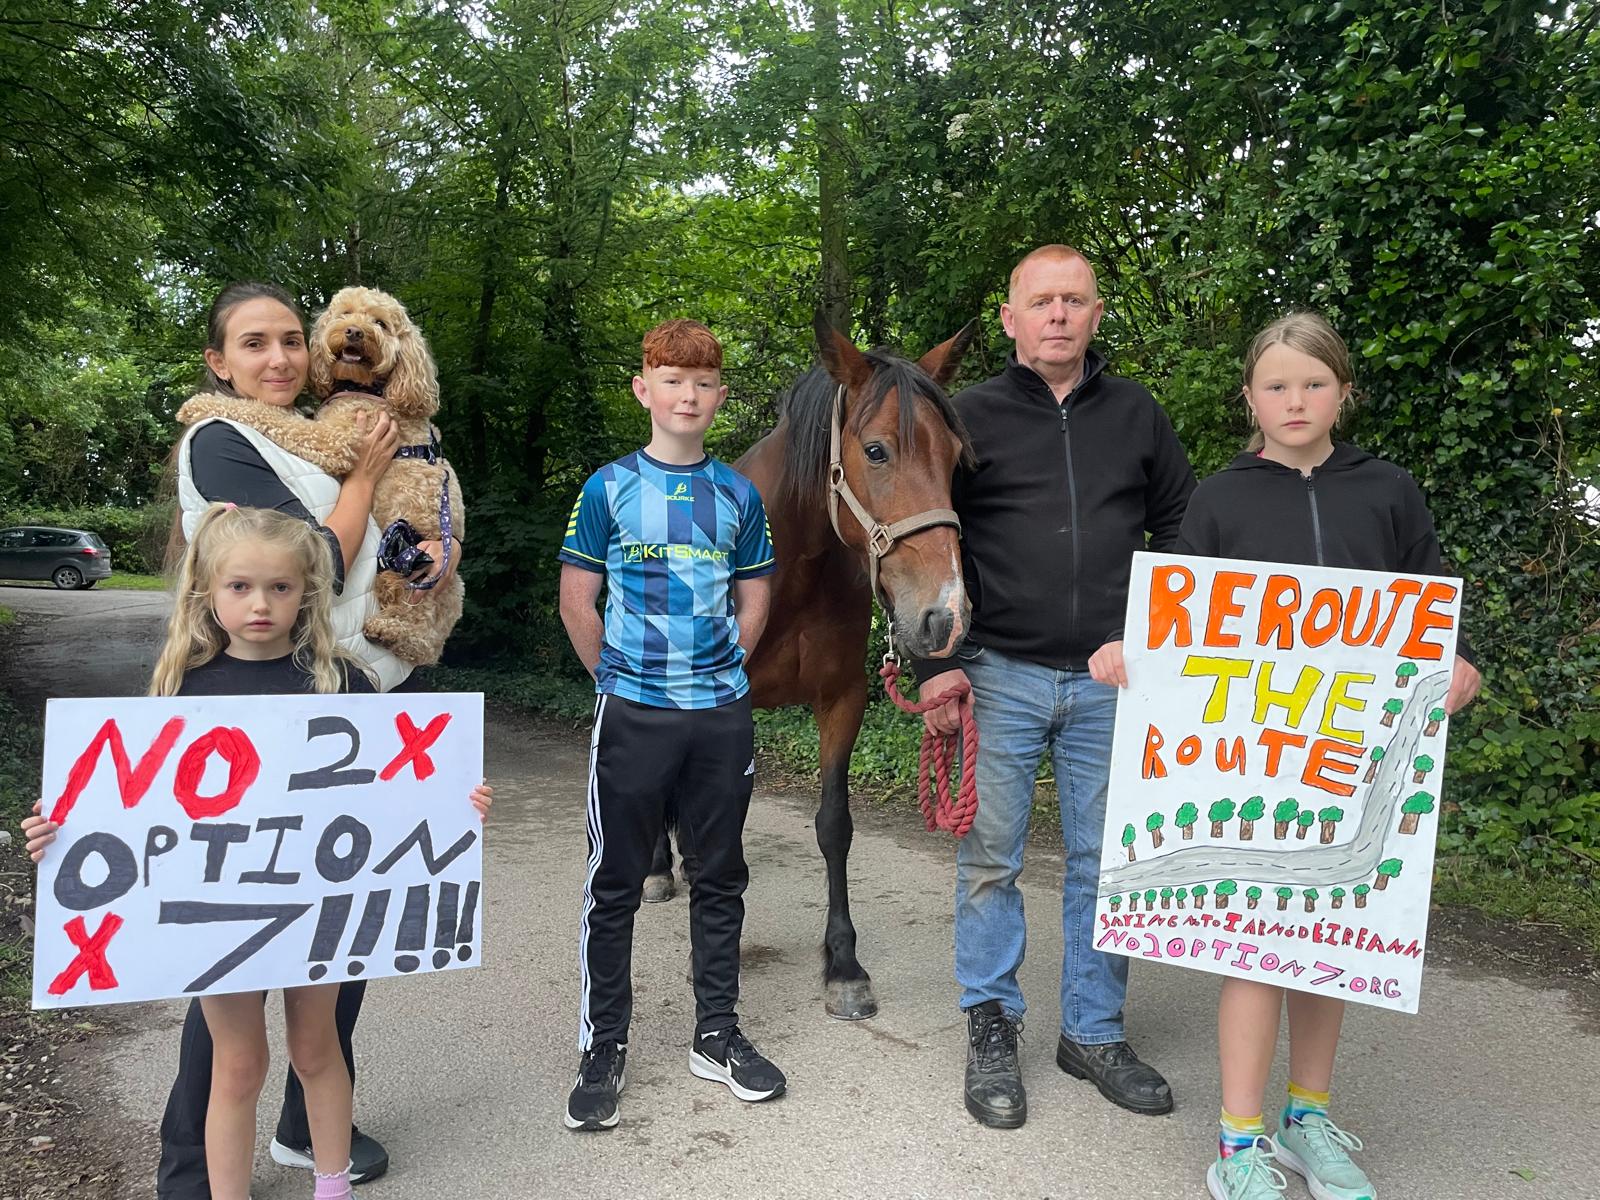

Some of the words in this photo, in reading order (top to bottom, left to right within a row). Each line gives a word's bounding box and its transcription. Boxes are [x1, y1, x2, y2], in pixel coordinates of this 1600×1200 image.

[1147, 564, 1458, 660] REROUTE
[1181, 655, 1376, 744] THE
[49, 714, 262, 825] NO
[287, 716, 376, 792] 2
[1142, 723, 1368, 797] ROUTE
[53, 814, 477, 911] OPTION
[1100, 913, 1178, 930] SAYING
